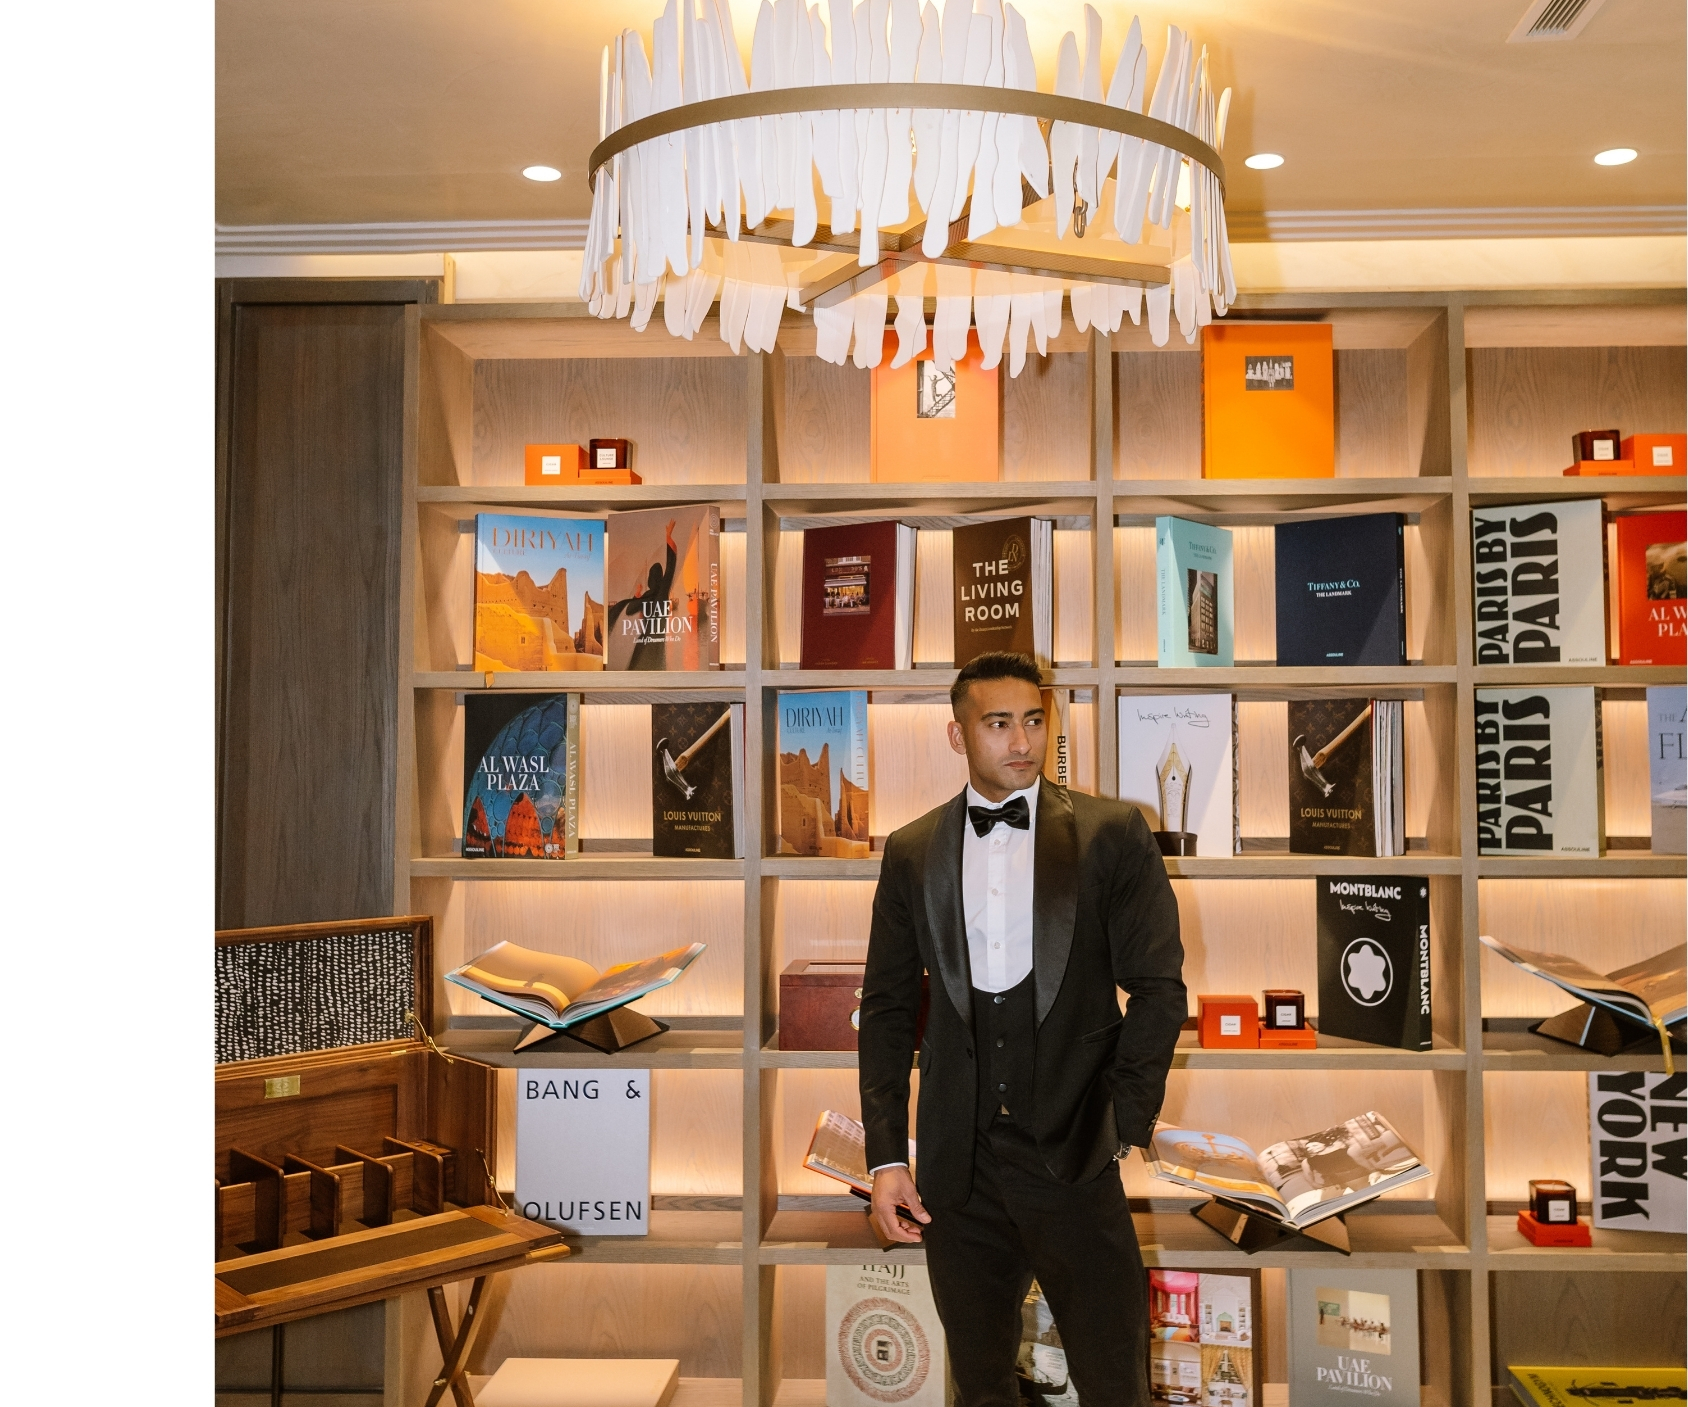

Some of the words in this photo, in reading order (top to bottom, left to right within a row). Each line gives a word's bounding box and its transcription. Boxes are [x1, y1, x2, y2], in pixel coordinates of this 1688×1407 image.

[493, 527, 592, 552] DIRIYAH
[1474, 517, 1507, 564] BY
[710, 563, 718, 586] UAE
[972, 559, 1009, 578] THE
[961, 580, 1023, 601] LIVING
[1509, 511, 1560, 664] PARIS
[642, 600, 673, 618] UAE
[710, 589, 719, 643] PAVILION
[965, 602, 1020, 622] ROOM
[1476, 568, 1510, 664] PARIS
[1648, 606, 1670, 621] AL
[622, 616, 693, 636] PAVILION
[786, 706, 843, 727] DIRIYAH
[1136, 708, 1172, 725] Inspire
[1173, 706, 1211, 728] Writing
[568, 742, 577, 759] AL
[478, 756, 499, 773] AL
[502, 755, 549, 773] WASL
[1056, 735, 1067, 789] BURBE
[487, 773, 540, 791] PLAZA
[568, 761, 577, 795] WASL
[1502, 695, 1554, 850] PARIS
[568, 798, 577, 838] PLAZA
[663, 810, 687, 821] LOUIS
[687, 811, 722, 822] VUITTON
[1300, 807, 1325, 818] LOUIS
[1326, 808, 1362, 820] VUITTON
[674, 824, 711, 832] MANUFACTURES
[1312, 821, 1351, 829] MANUFACTURES
[1329, 881, 1402, 900] MONTBLANC
[1419, 924, 1430, 1015] MONTBLANC
[526, 1079, 599, 1100] BANG
[625, 1079, 641, 1099] &
[1597, 1071, 1650, 1220] YORK
[523, 1201, 642, 1221] OLUFSEN
[867, 1284, 911, 1296] PILGRIMAGE
[875, 1277, 890, 1285] THE
[891, 1280, 910, 1288] ARTS
[1337, 1355, 1371, 1374] UAE
[1316, 1366, 1393, 1392] PAVILION
